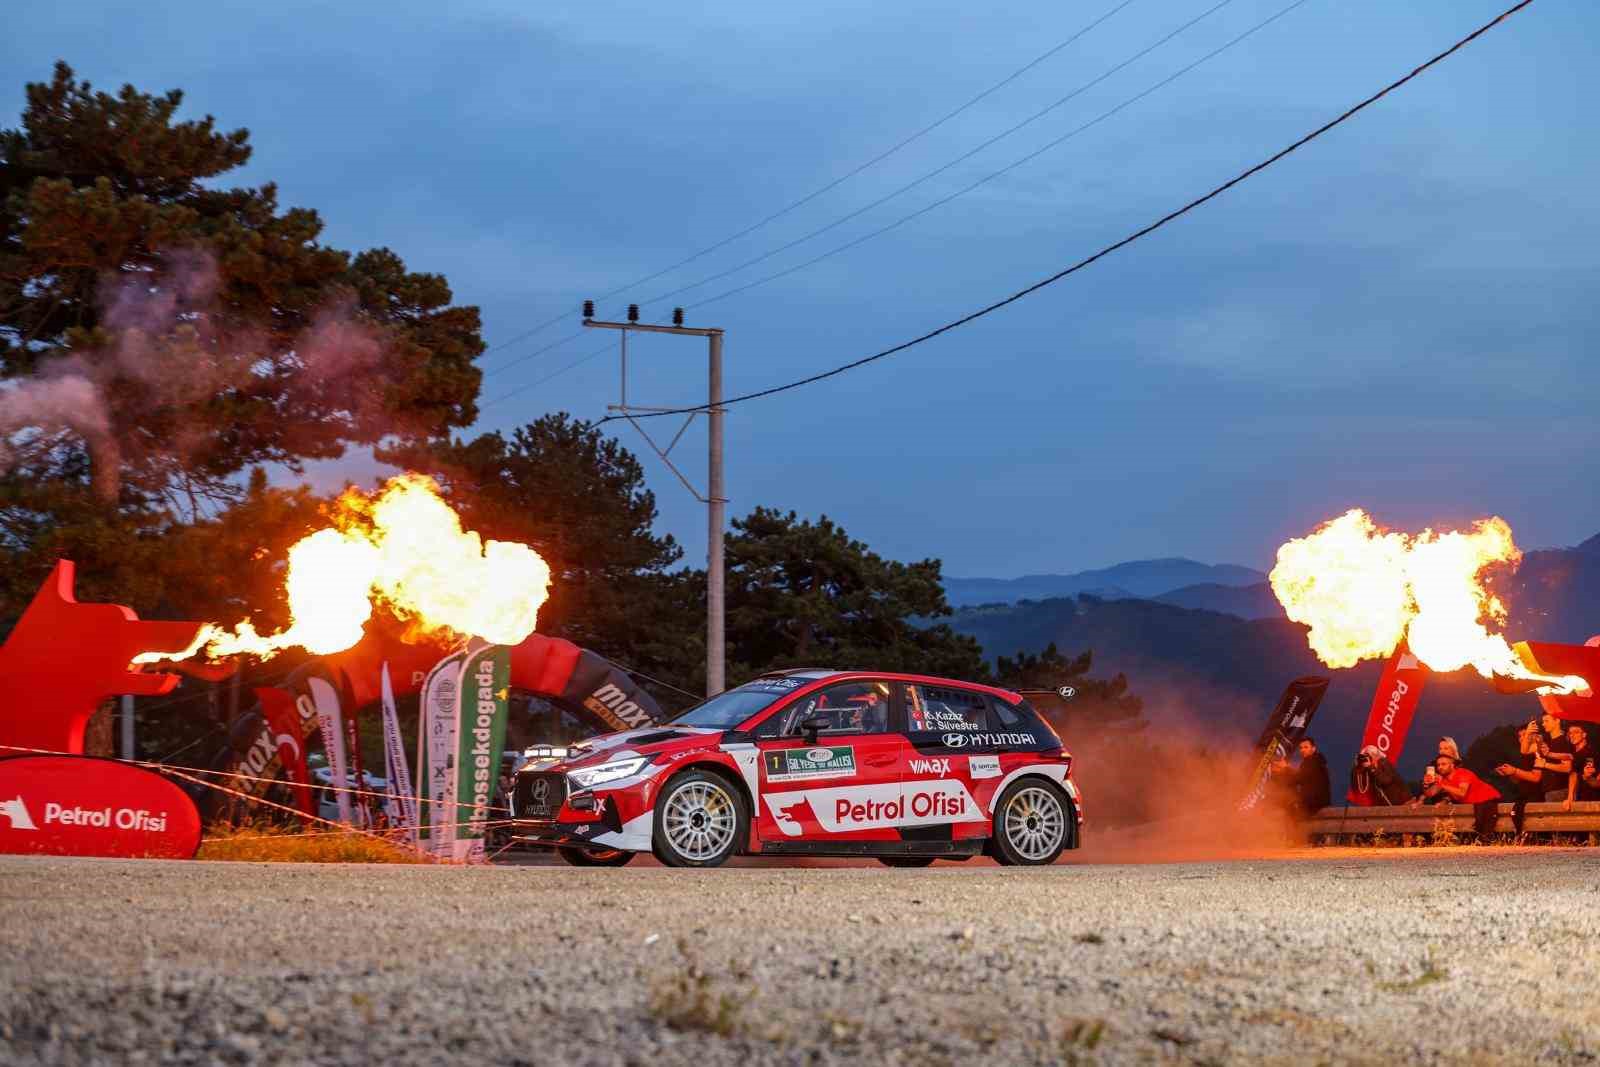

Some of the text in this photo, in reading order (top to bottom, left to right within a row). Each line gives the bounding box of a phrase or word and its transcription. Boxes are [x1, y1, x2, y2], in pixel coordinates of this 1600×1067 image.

[1382, 680, 1409, 734] Petrol
[938, 721, 979, 730] Silvestre
[971, 733, 1037, 746] HYUNDAI
[772, 756, 779, 769] 1
[44, 802, 167, 833] Petrol Ofisi
[836, 790, 966, 824] Petrol Ofisi
